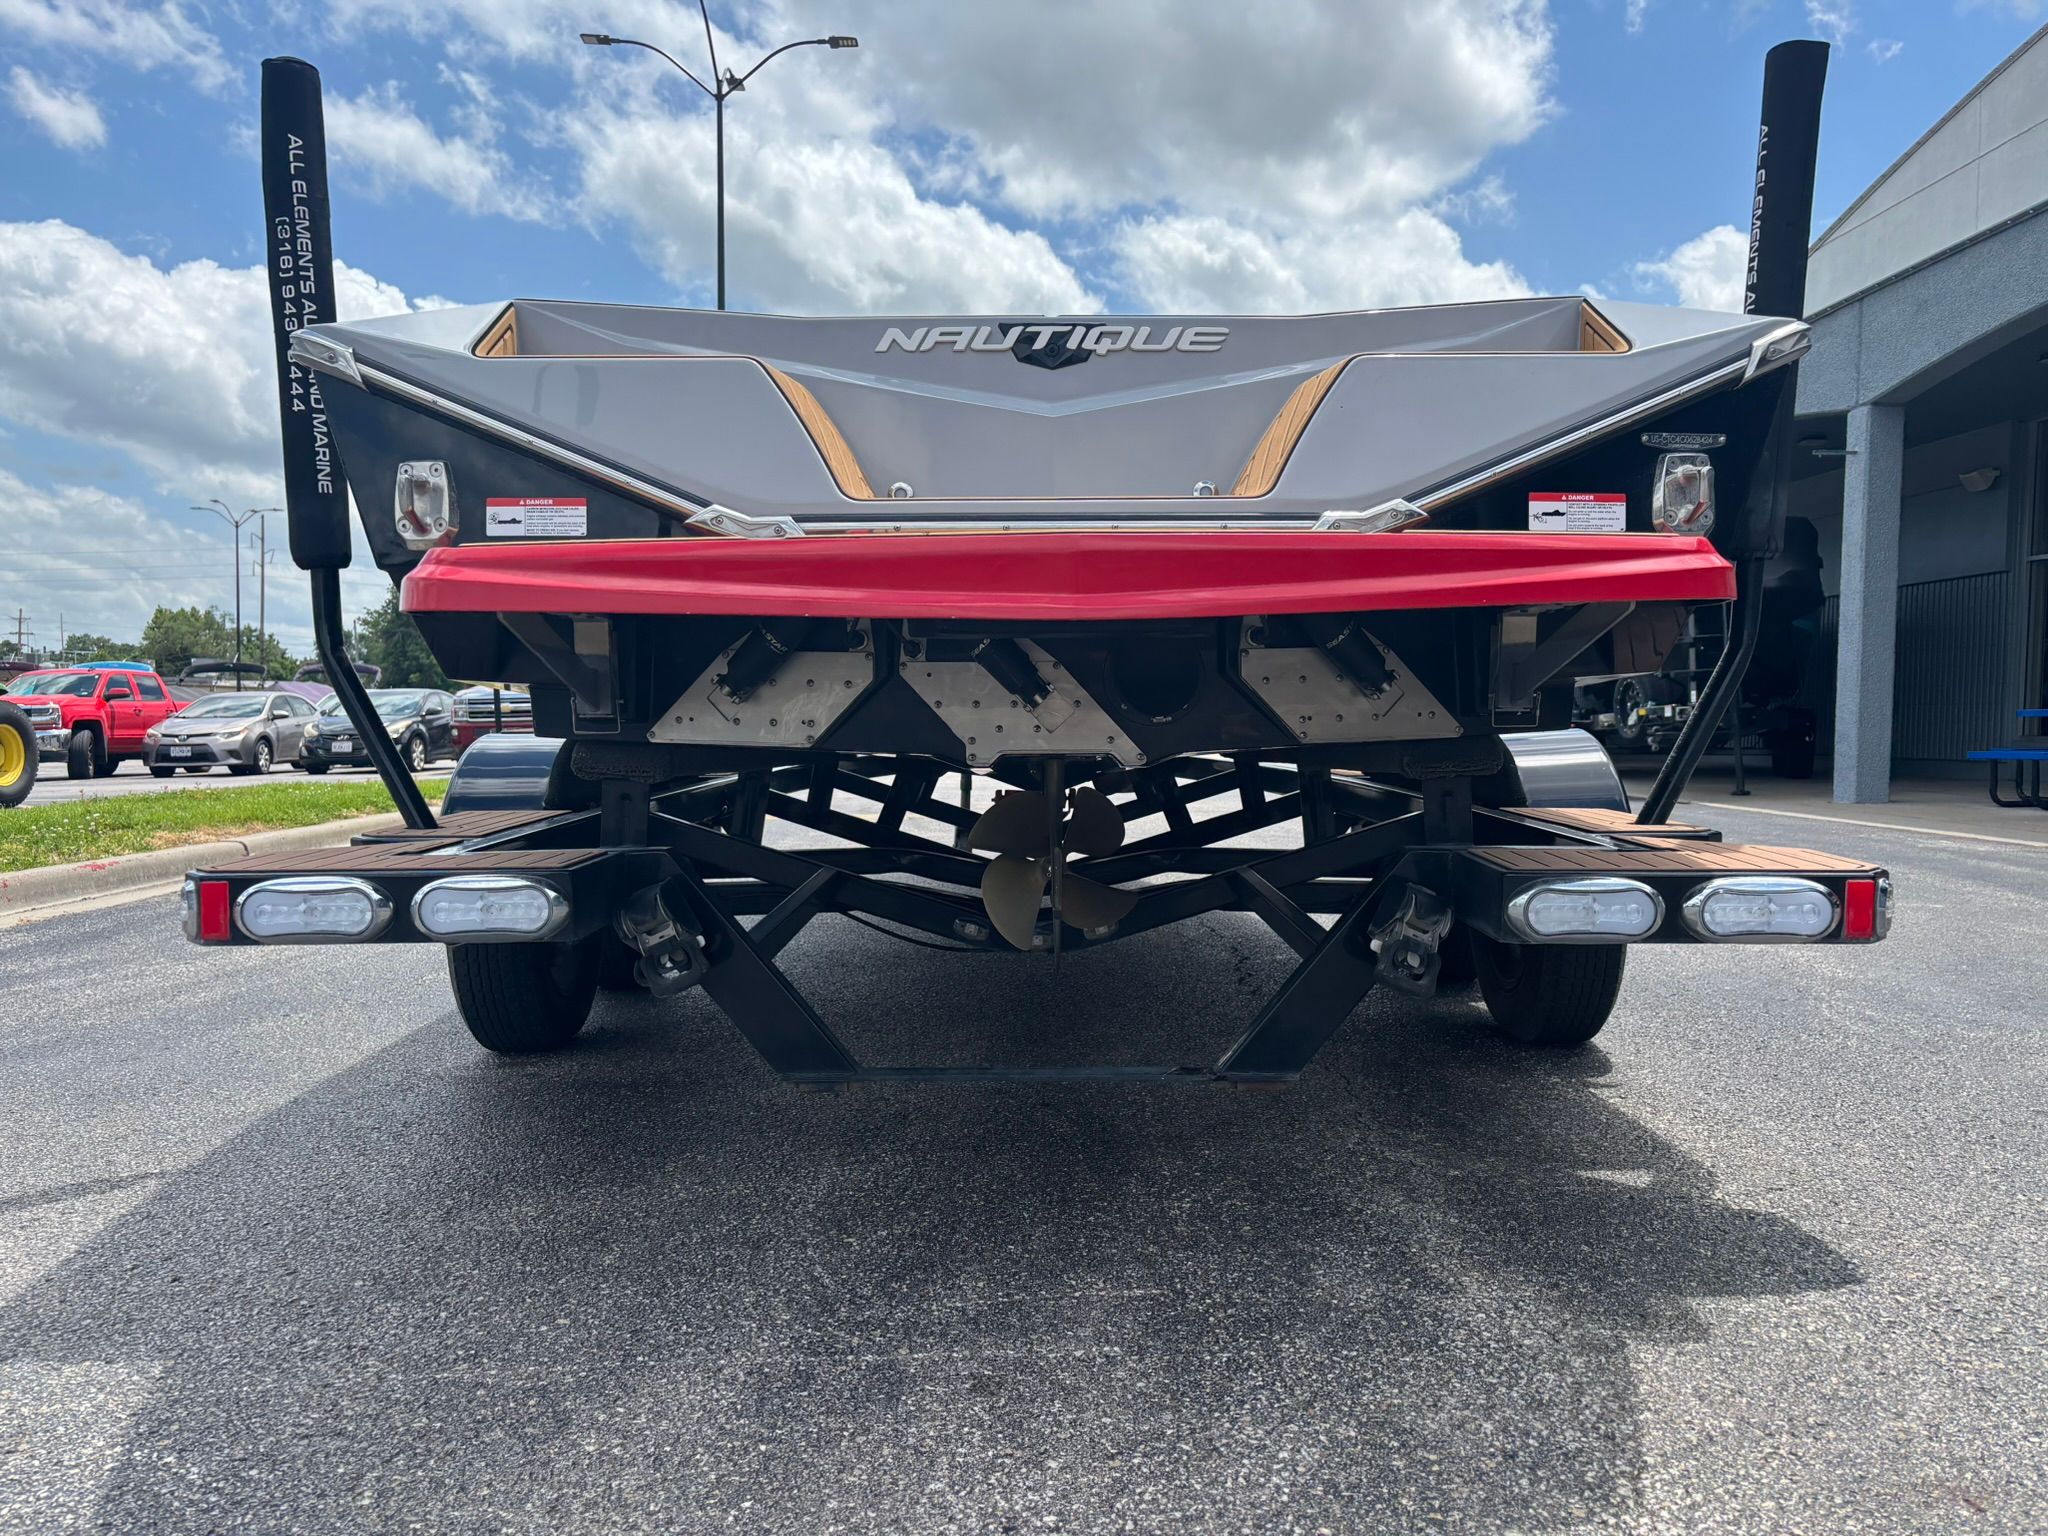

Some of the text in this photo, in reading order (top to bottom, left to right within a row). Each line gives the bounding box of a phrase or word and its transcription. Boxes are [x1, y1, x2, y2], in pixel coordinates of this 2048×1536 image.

[287, 133, 305, 175] ALL
[1759, 124, 1769, 167] ALL
[275, 216, 294, 278] (316)
[291, 179, 316, 294] ELEMENTS
[1747, 168, 1765, 285] ELEMENTS
[875, 325, 1230, 356] NAUTIQUE
[312, 413, 333, 495] MARINE
